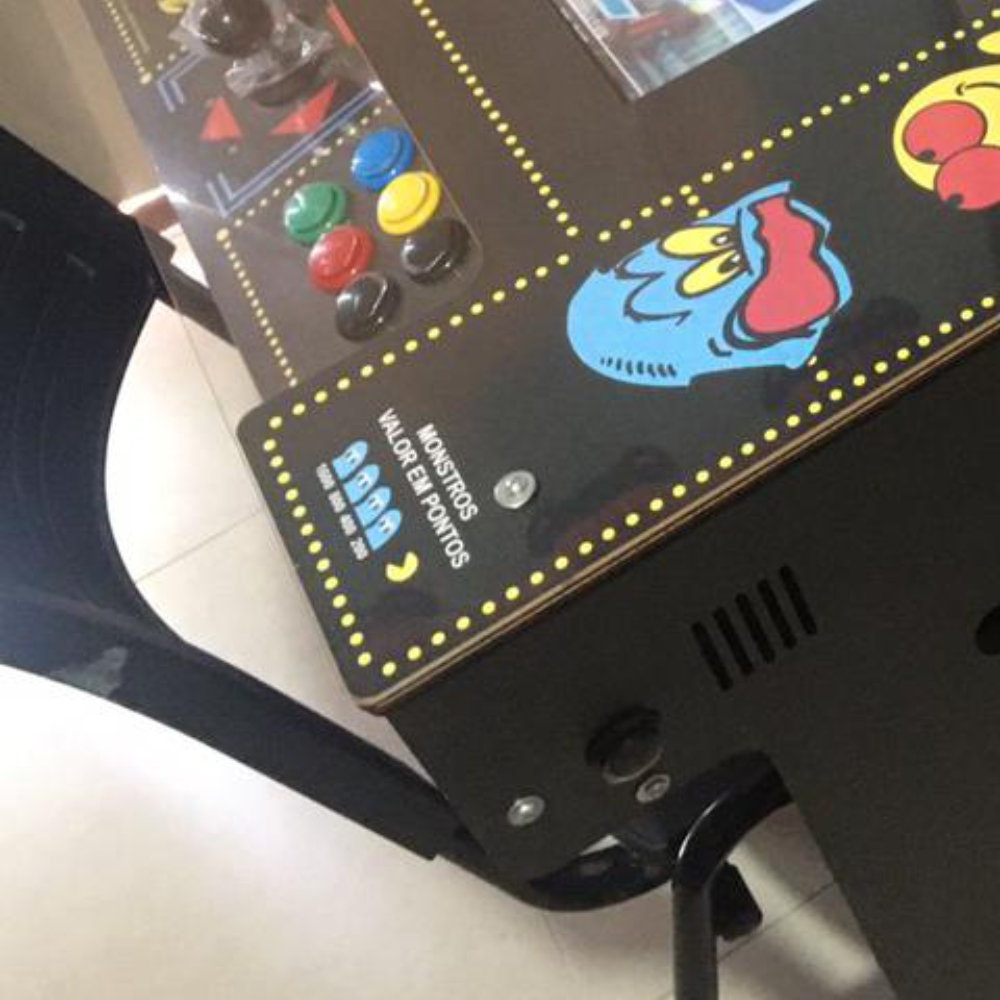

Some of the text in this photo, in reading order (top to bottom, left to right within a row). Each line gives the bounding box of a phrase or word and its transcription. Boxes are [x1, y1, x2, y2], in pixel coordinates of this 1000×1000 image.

[377, 408, 470, 569] VALOR EM PONTOS
[416, 423, 479, 522] MONSTROS
